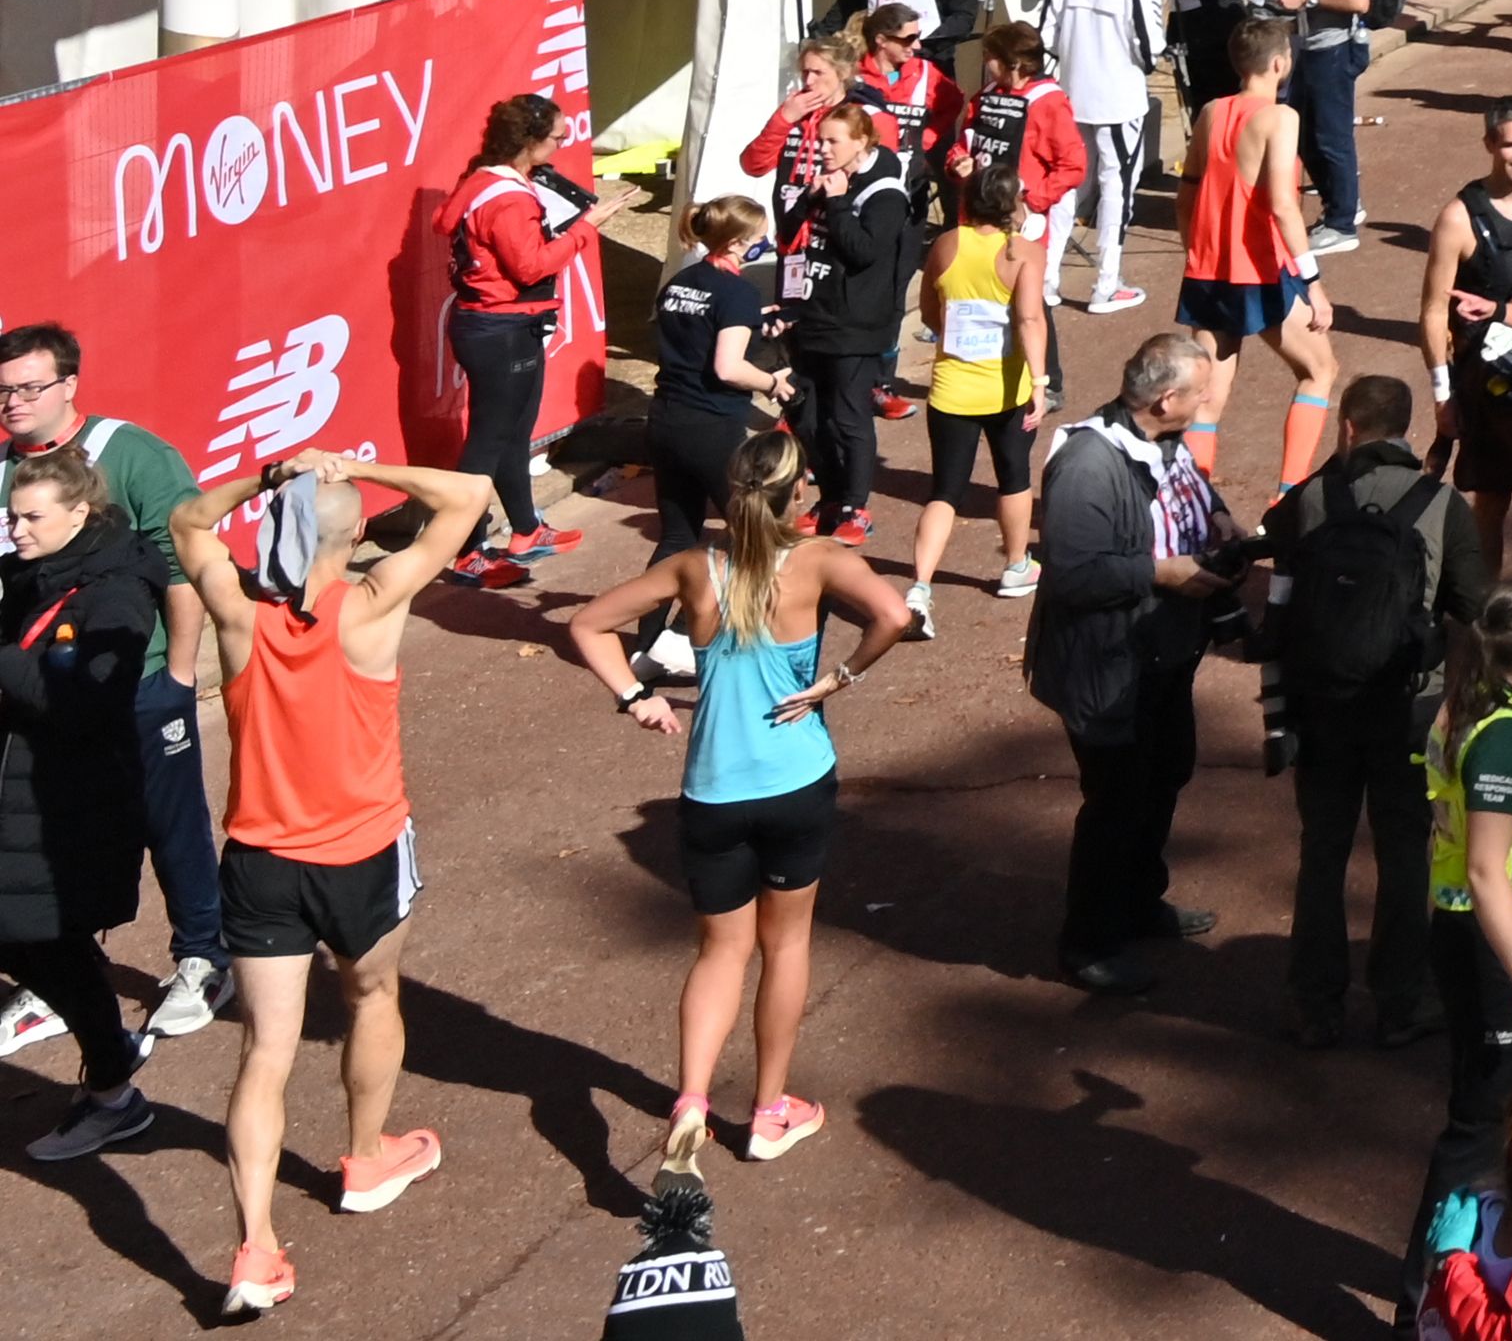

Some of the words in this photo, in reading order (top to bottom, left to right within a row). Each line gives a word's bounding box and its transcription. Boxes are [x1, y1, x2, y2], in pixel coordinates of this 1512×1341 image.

[113, 58, 434, 261] MONEY
[210, 134, 260, 208] Virgin
[1482, 792, 1505, 803] TEAM
[621, 1264, 692, 1300] LDN
